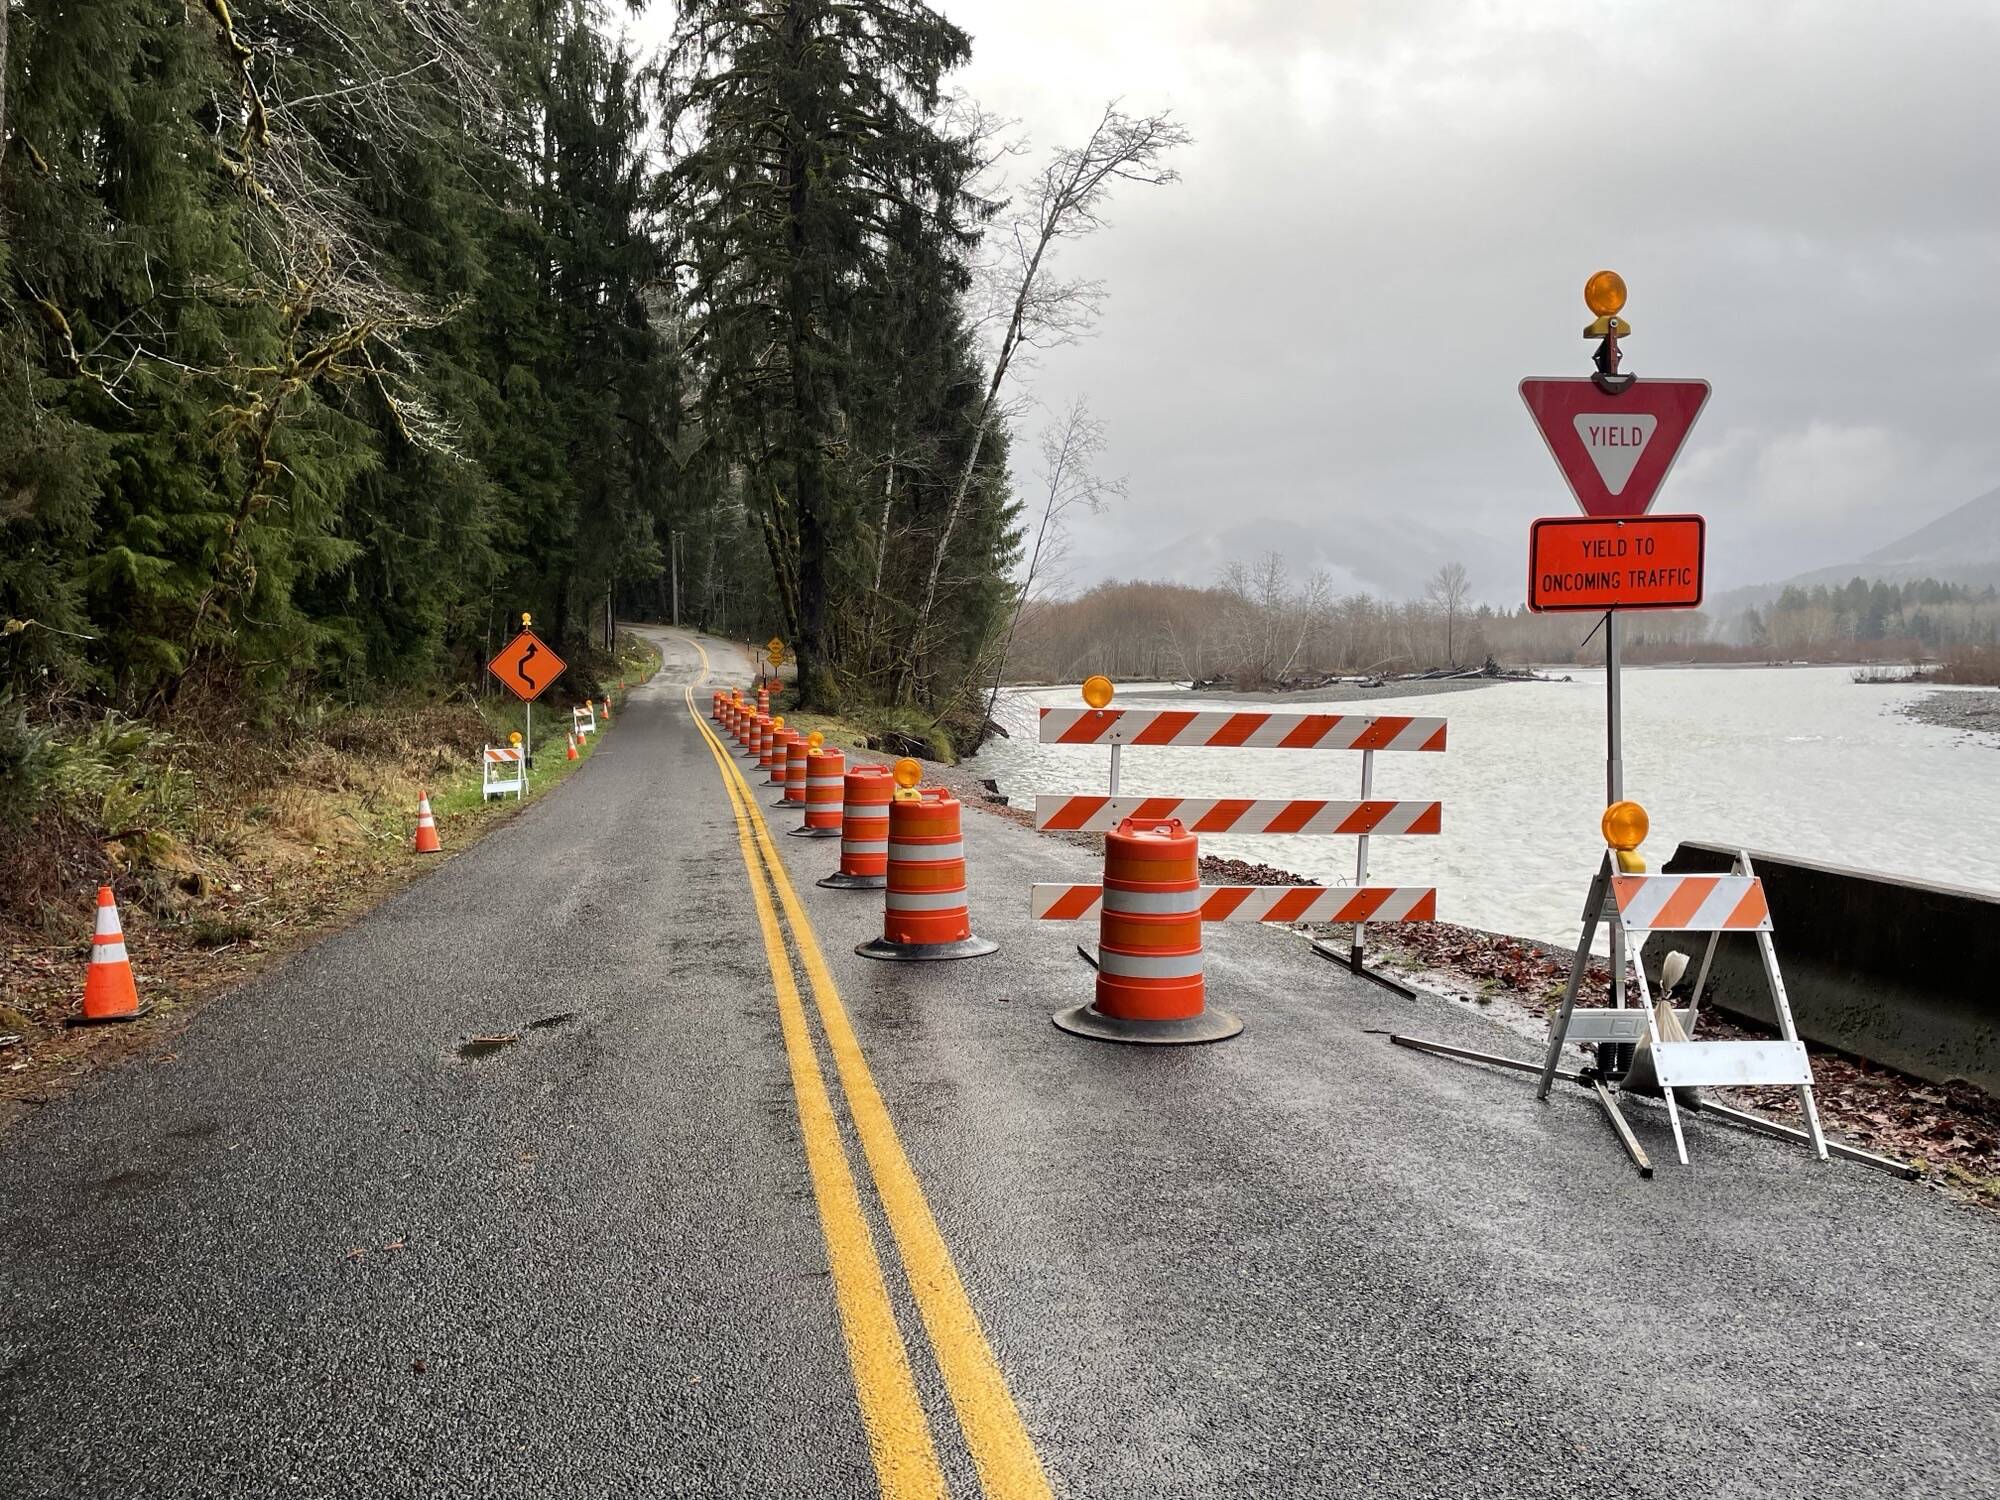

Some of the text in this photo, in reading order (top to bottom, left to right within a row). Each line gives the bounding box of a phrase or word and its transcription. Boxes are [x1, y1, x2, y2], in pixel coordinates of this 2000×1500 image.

[1589, 426, 1643, 447] YIELD
[1582, 537, 1655, 558] YIELD TO
[1543, 568, 1691, 592] ONCOMING TRAFFIC
